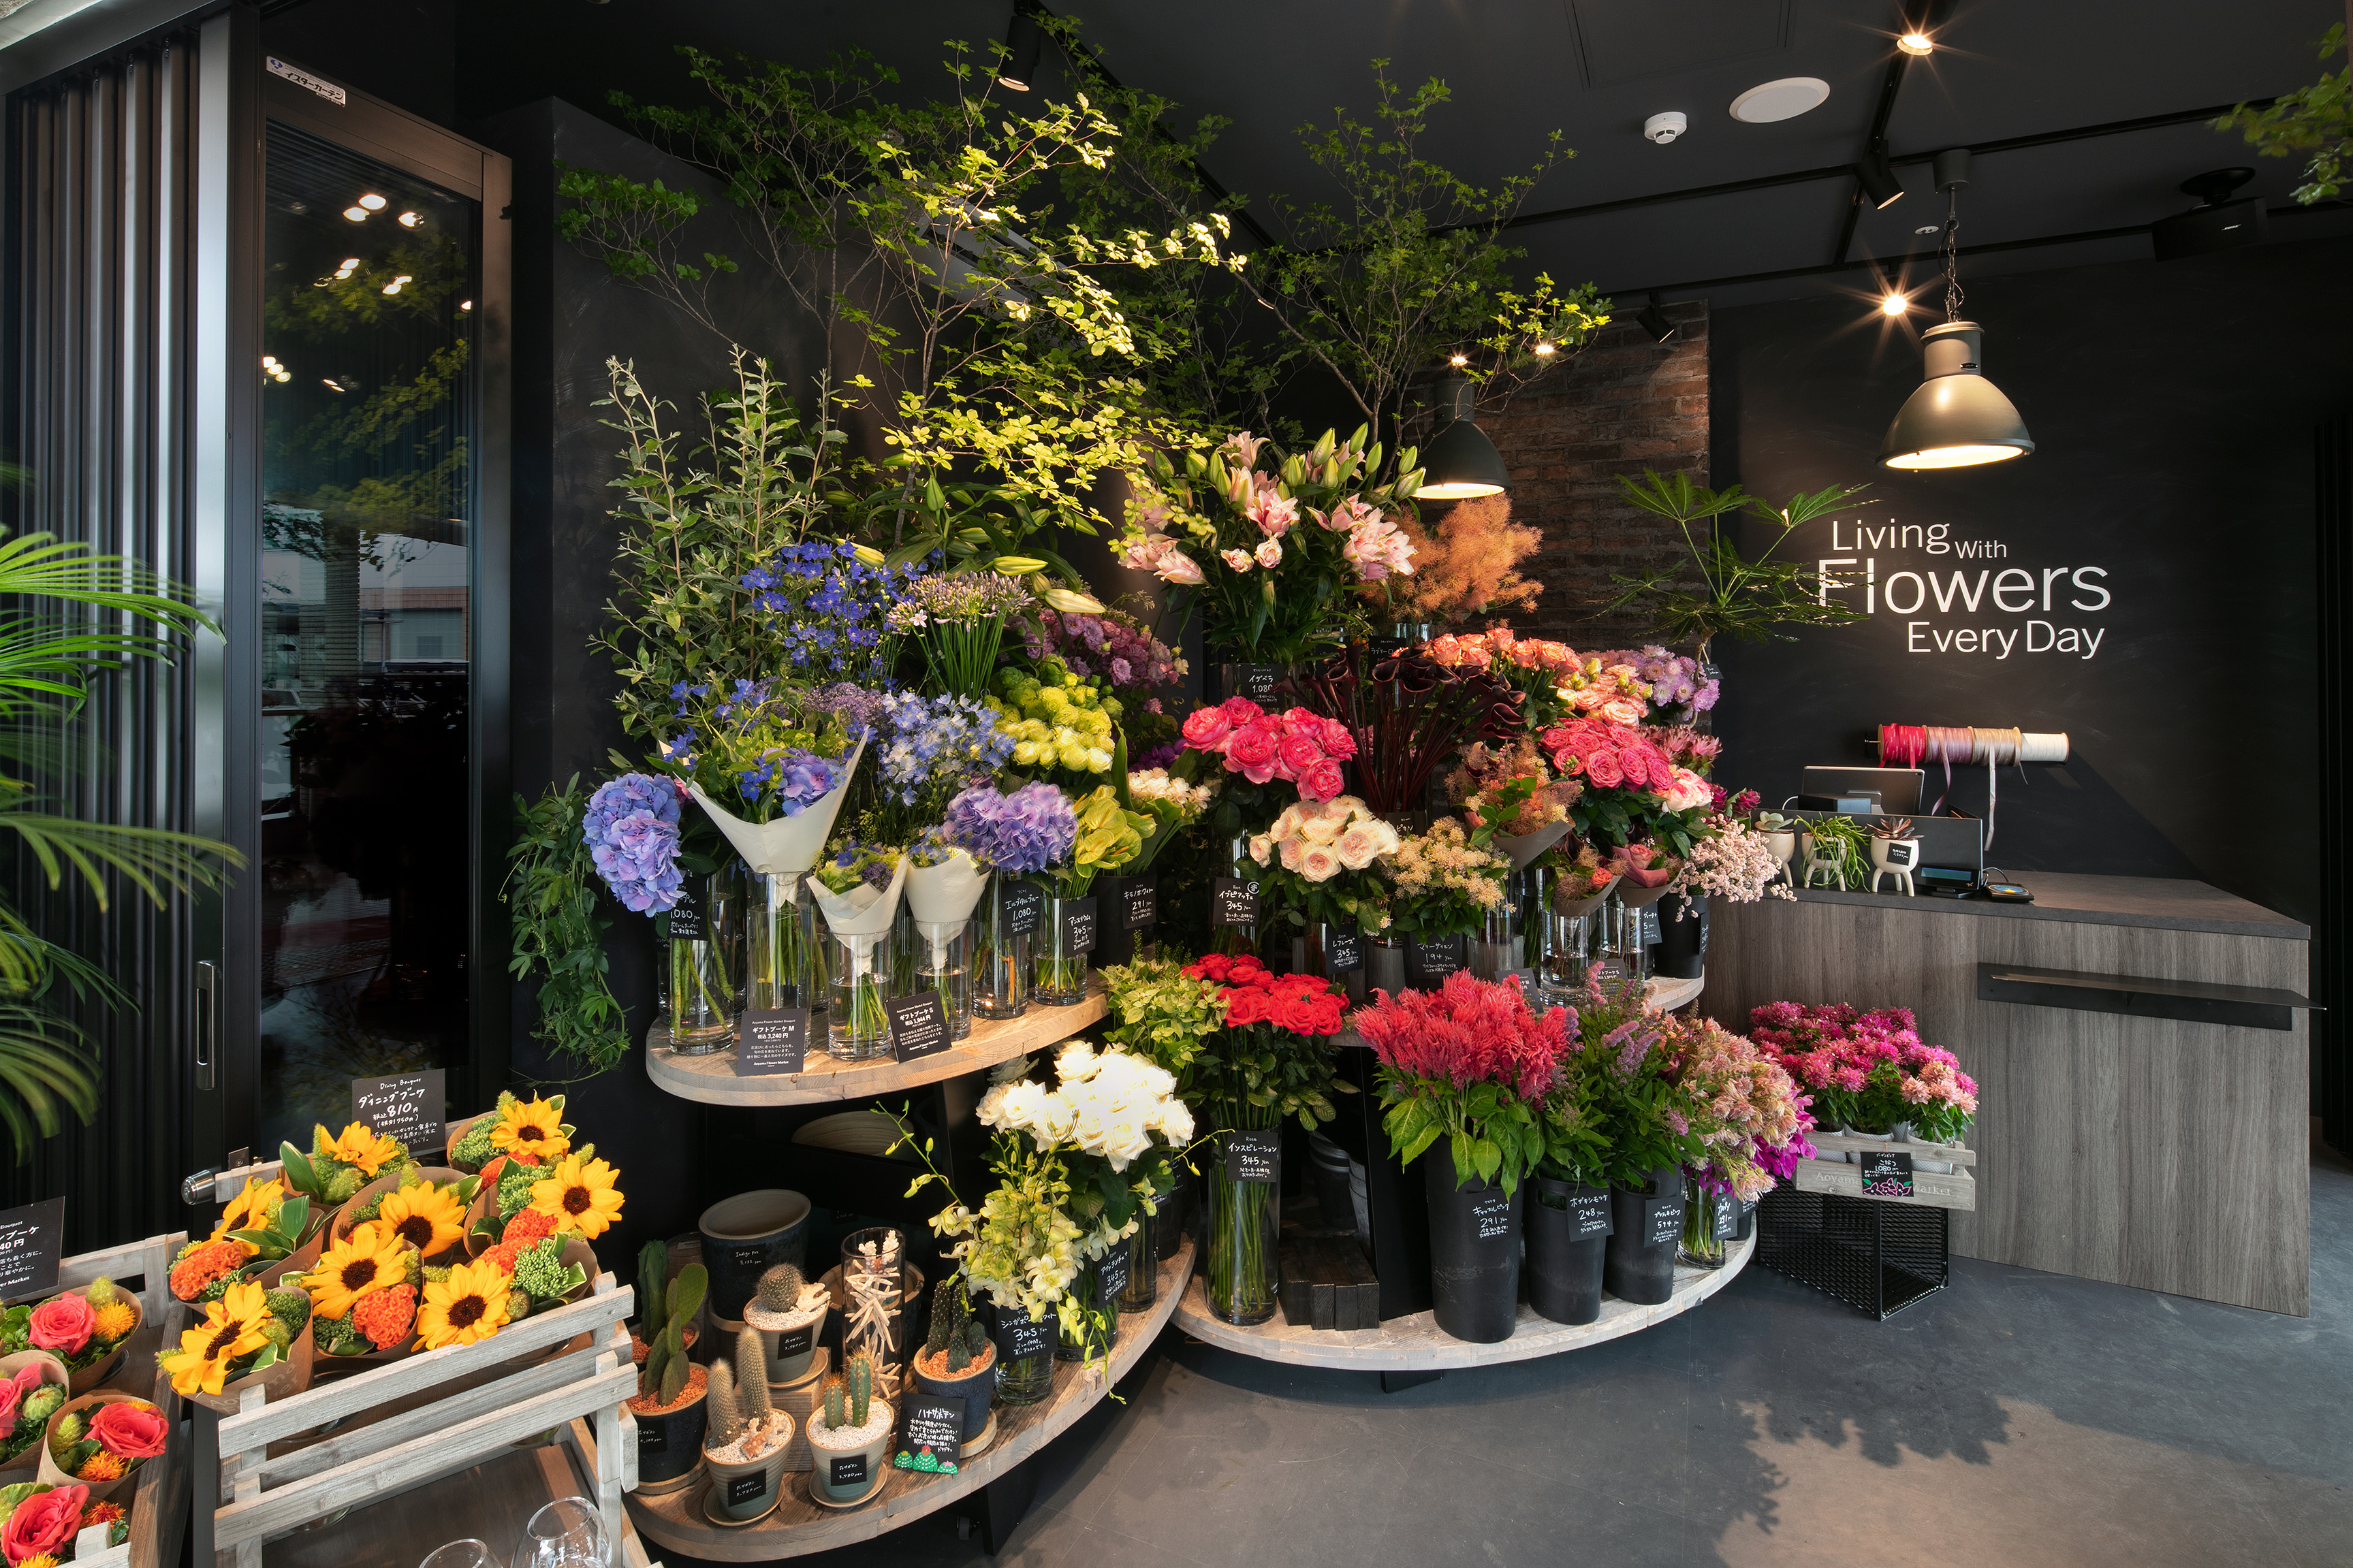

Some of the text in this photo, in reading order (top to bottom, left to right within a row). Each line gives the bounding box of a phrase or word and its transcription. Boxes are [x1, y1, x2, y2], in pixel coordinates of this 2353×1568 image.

[285, 72, 344, 99] イスターカーテン
[1833, 518, 2007, 559] Living With
[1818, 558, 2111, 614] Flowers
[1908, 620, 2105, 660] Every Day
[1248, 675, 1274, 683] イザベラ
[1132, 899, 1145, 911] 291
[1226, 900, 1243, 911] 345
[1073, 925, 1087, 938] 345
[1336, 948, 1351, 959] 345
[1425, 953, 1442, 963] 194
[900, 1009, 929, 1021] ギフトブーケ
[1228, 1142, 1277, 1153] インスピレーション
[1241, 1155, 1259, 1166] 345
[1578, 1208, 1596, 1220] 248
[1718, 1214, 1728, 1225] 291
[0, 1220, 23, 1230] Bouquet
[1480, 1216, 1498, 1228] 291
[1657, 1220, 1672, 1229] 594
[7, 1275, 30, 1285] Market
[1107, 1270, 1119, 1286] 345
[1013, 1327, 1047, 1341] 345 yen
[917, 1407, 955, 1420] ハナサボテン
